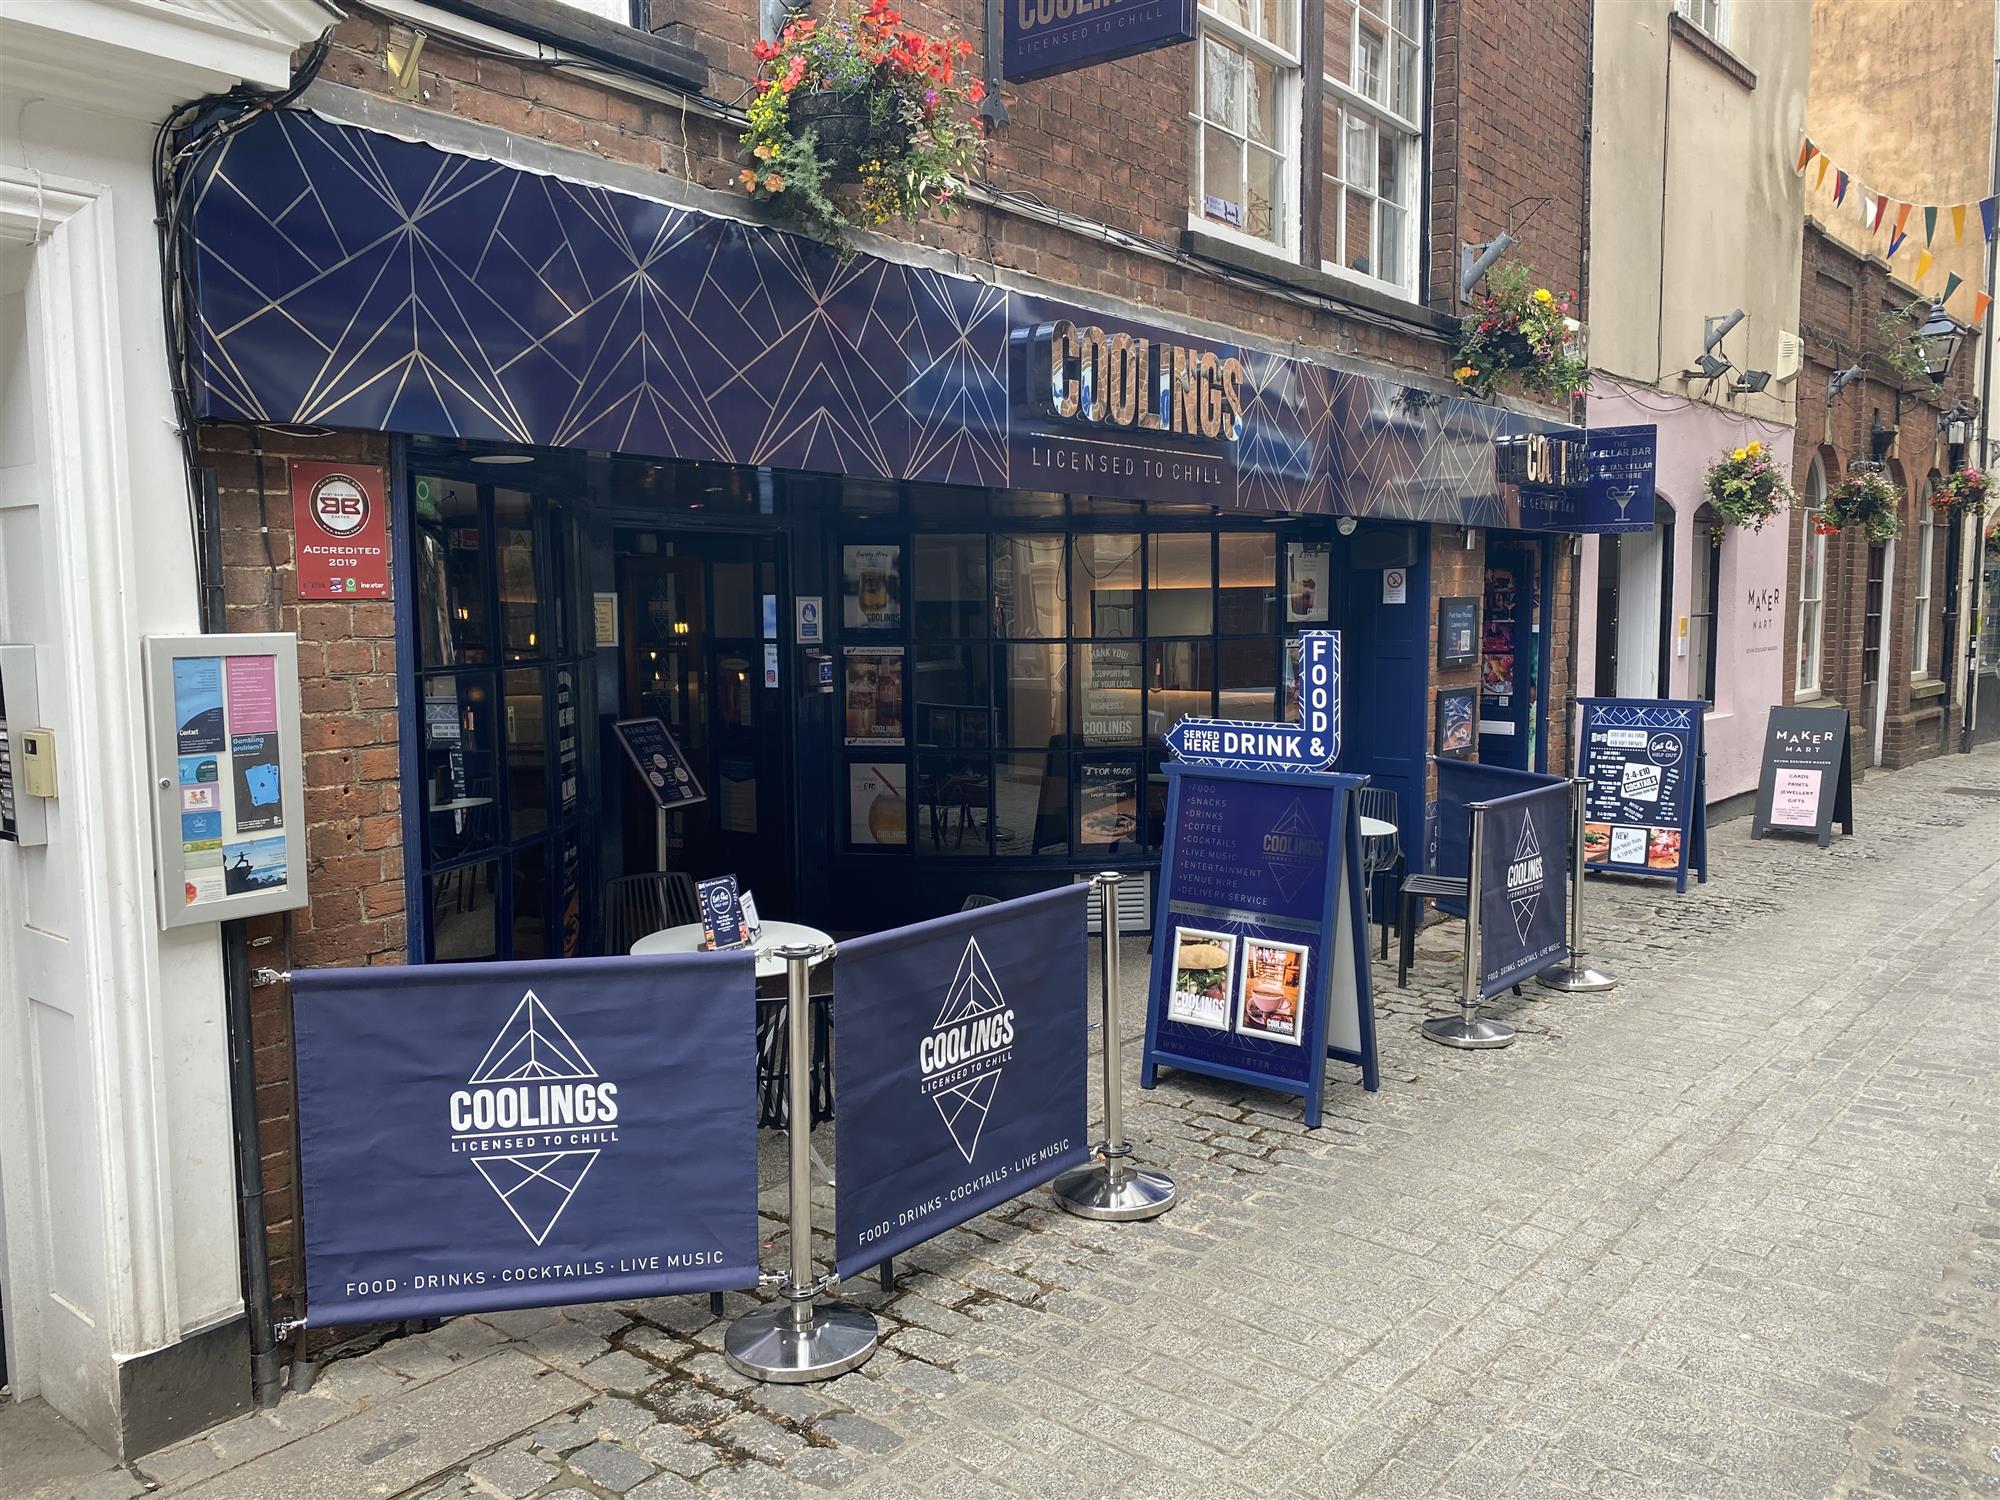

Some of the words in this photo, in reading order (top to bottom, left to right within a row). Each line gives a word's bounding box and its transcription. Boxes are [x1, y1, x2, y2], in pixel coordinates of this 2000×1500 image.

[1018, 28, 1089, 56] LICENSED
[1096, 21, 1111, 34] TO
[1118, 7, 1163, 29] CHILL
[1050, 319, 1244, 442] COOLINGS
[1593, 449, 1629, 458] CELLAR
[1631, 447, 1651, 456] BAR
[1032, 447, 1134, 476] LICENSED
[1144, 460, 1164, 478] TO
[1172, 463, 1222, 485] CHILL
[1625, 462, 1653, 470] CELLAR
[1626, 472, 1642, 480] HIRE
[303, 545, 380, 555] ACCREDITED
[1748, 588, 1780, 611] MAKER
[867, 613, 900, 622] COOLINGS
[1752, 619, 1773, 630] MART
[1112, 648, 1130, 660] YOU!
[1311, 640, 1329, 733] FOOD
[1083, 720, 1132, 735] COOLINGS
[1183, 729, 1220, 740] SERVED
[1776, 730, 1834, 744] MAKER
[233, 744, 264, 752] problem?
[1183, 739, 1220, 753] HERE
[1224, 732, 1302, 758] DRINK
[1309, 737, 1326, 757] &
[1651, 741, 1664, 751] Eat
[1665, 740, 1680, 751] Out
[1192, 784, 1216, 794] FOOD
[1625, 776, 1657, 792] COCKTAILS
[1190, 798, 1226, 807] SNACKS
[1189, 810, 1224, 820] DRINKS
[1188, 823, 1223, 833] COFFEE
[1186, 835, 1237, 848] COCKTAILS
[1616, 832, 1629, 840] NEW!
[1263, 833, 1325, 857] COOLINGS
[1185, 849, 1205, 858] LIVE
[1208, 851, 1238, 861] MUSIC
[1184, 861, 1262, 878] ENTERTAINMENT
[1506, 856, 1543, 888] COOLINGS
[1182, 873, 1212, 885] VENUE
[1216, 878, 1238, 888] HIRE
[1181, 886, 1225, 899] DELIVERY
[1228, 893, 1268, 905] SERVICE
[1487, 970, 1498, 981] FOOD
[1501, 962, 1516, 976] DRINKS
[1517, 952, 1538, 967] COCKTAILS
[1540, 947, 1548, 957] LIVE
[1548, 941, 1561, 952] MUSIC
[1175, 991, 1226, 1012] COOLINGS
[1266, 1018, 1293, 1030] COOLINGS
[920, 1009, 1015, 1074] COOLINGS
[921, 1068, 968, 1094] LICENSED
[972, 1062, 982, 1073] TO
[986, 1052, 1013, 1068] CHILL
[450, 1082, 618, 1132] COOLINGS
[451, 1137, 536, 1153] LICENSED
[543, 1135, 562, 1146] TO
[570, 1132, 619, 1145] CHILL
[858, 1221, 890, 1246] FOOD
[899, 1197, 942, 1226] DRINKS
[950, 1167, 1008, 1202] COCKTAILS
[1015, 1154, 1038, 1173] LIVE
[1039, 1138, 1070, 1161] MUSIC
[346, 1279, 397, 1297] FOOD
[414, 1271, 486, 1290] DRINKS
[502, 1261, 605, 1283] COCKTAILS
[620, 1255, 659, 1273] LIVE
[667, 1250, 724, 1268] MUSIC
